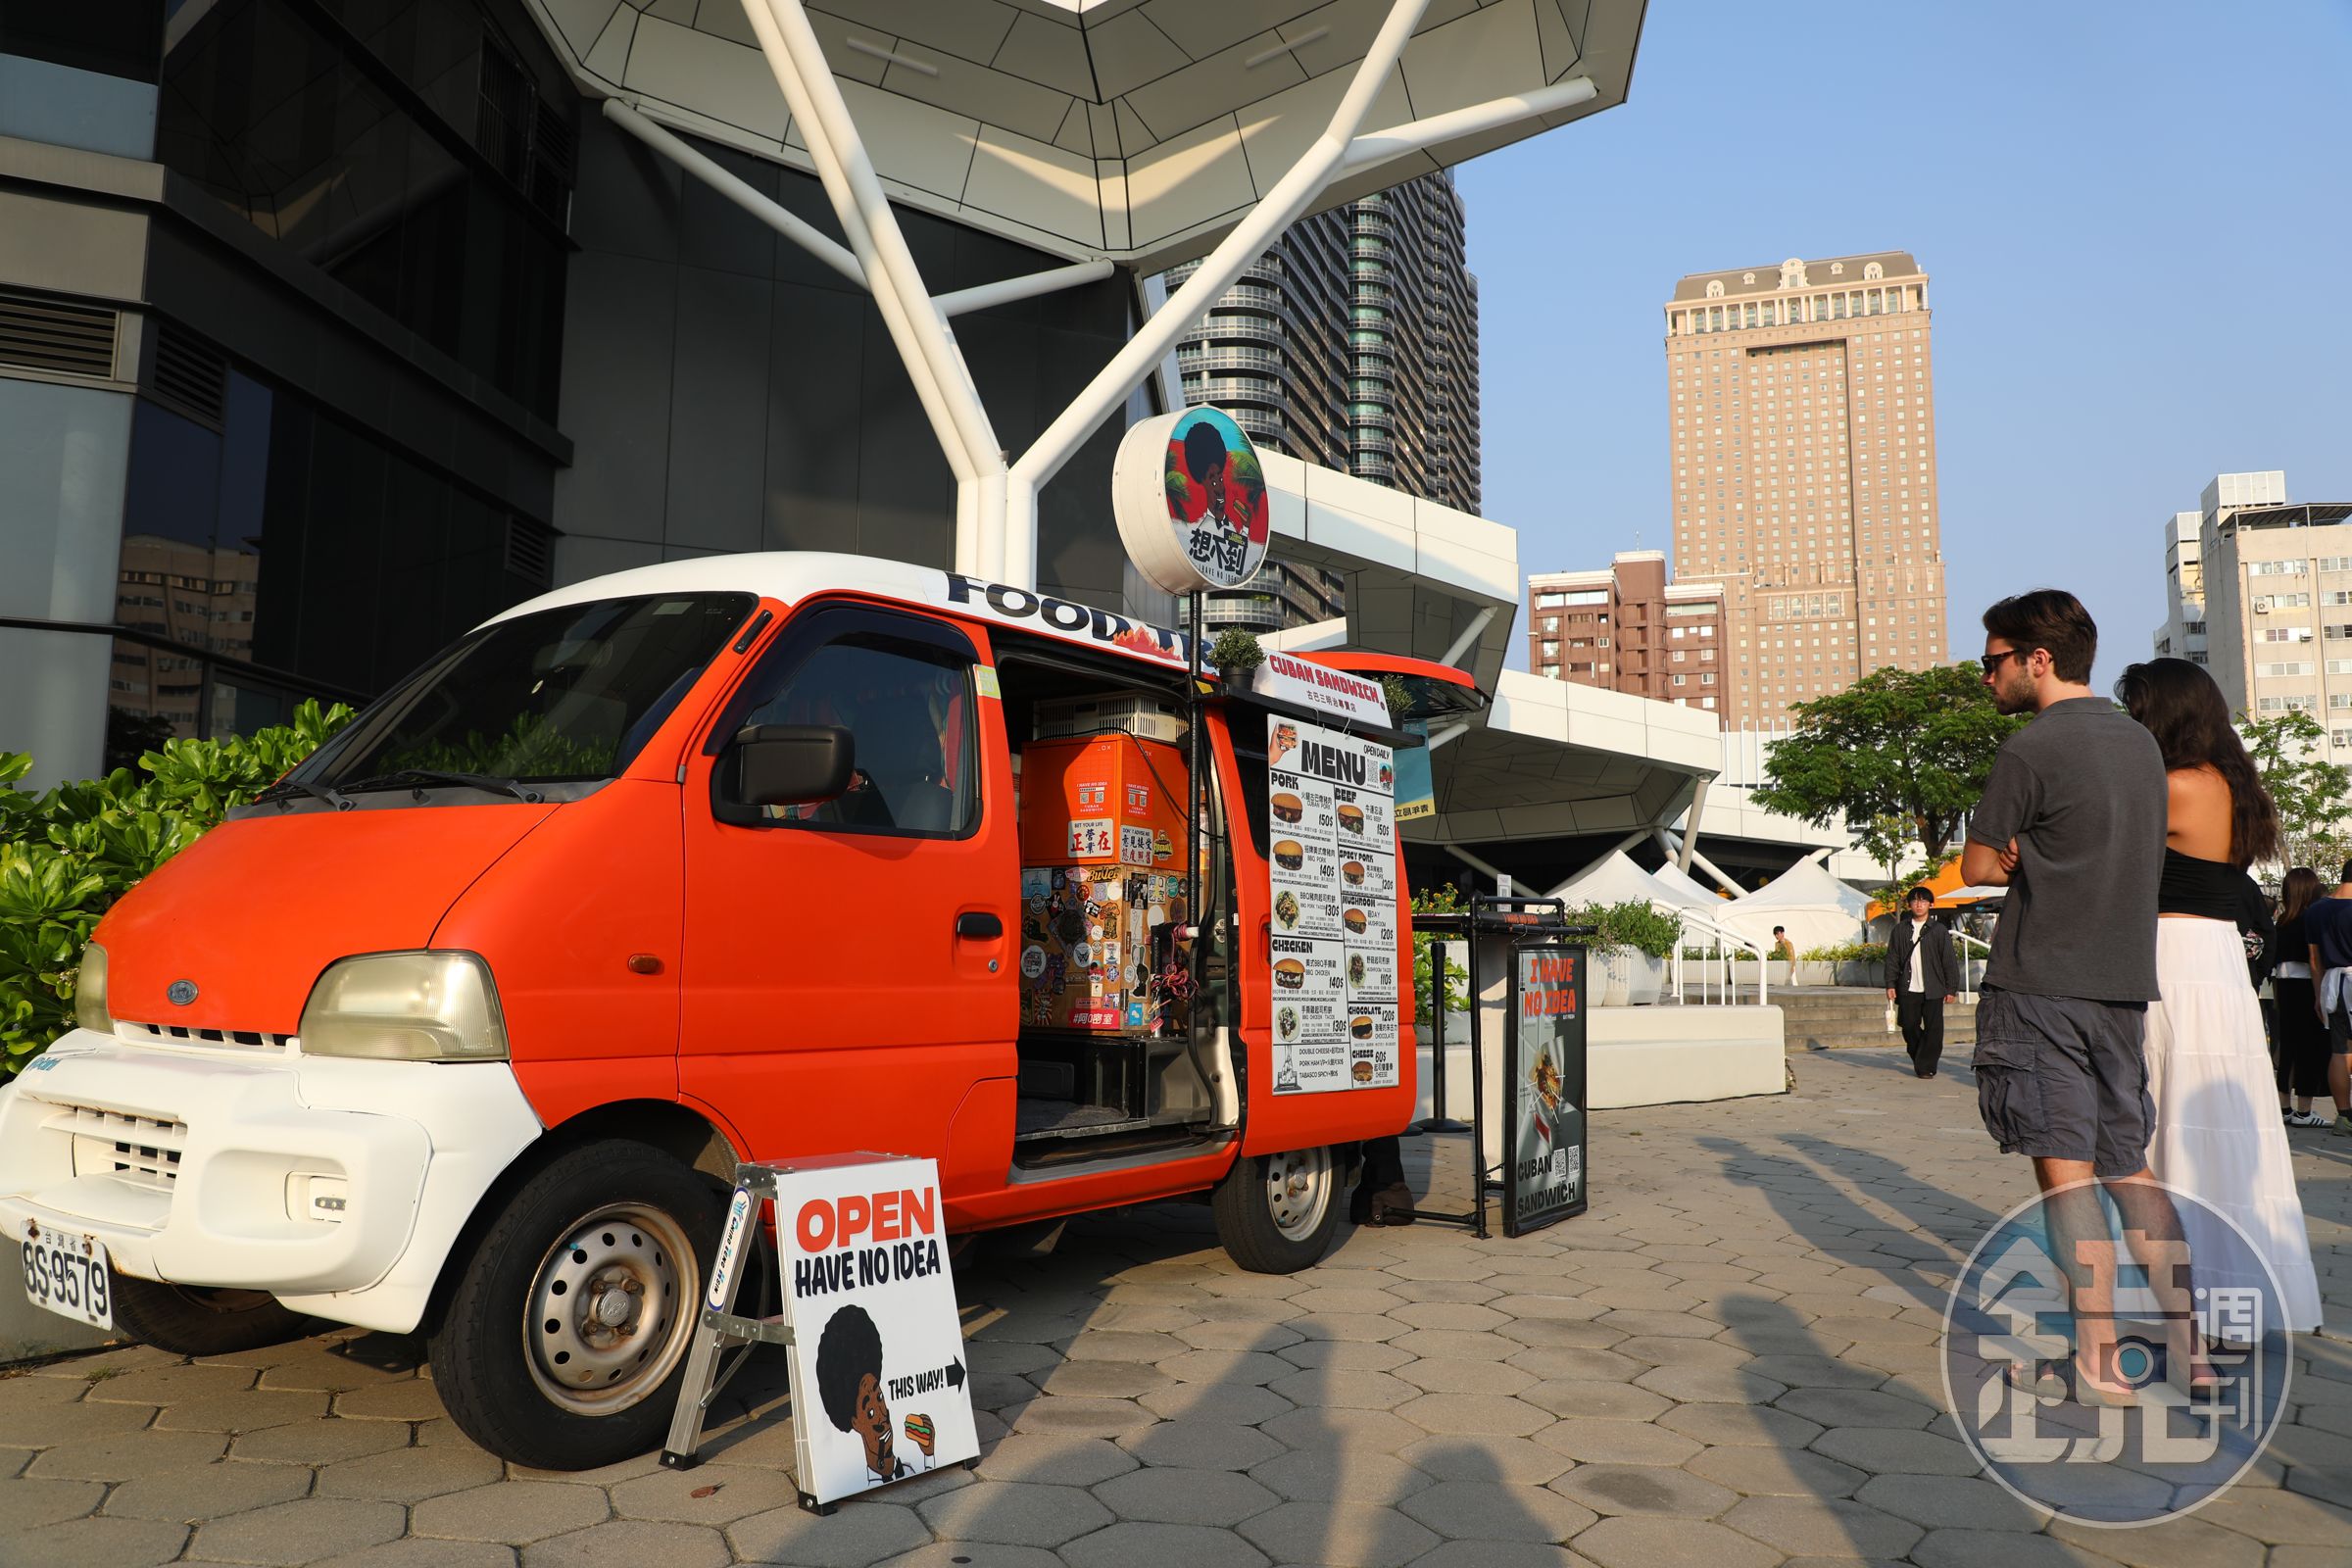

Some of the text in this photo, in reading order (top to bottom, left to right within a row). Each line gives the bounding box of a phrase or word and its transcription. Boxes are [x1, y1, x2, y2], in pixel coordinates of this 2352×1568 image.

[1189, 527, 1249, 576] 想不到
[945, 571, 1133, 641] FOOD
[1269, 654, 1380, 704] CUBAN SANDWICH
[1306, 689, 1357, 712] 古巴三明治專賣店
[1363, 744, 1390, 760] OPEN DAILY
[1301, 740, 1366, 786] MENU
[1271, 771, 1299, 790] PORK
[1335, 787, 1357, 804] BEEF
[1318, 813, 1334, 827] 150$
[1377, 823, 1390, 837] 150$
[1340, 849, 1374, 862] SPICY PORK
[1319, 864, 1335, 877] 140$
[1382, 879, 1394, 890] 120$
[1342, 896, 1376, 907] MUSHROOM
[1325, 905, 1340, 917] 130$
[1381, 928, 1394, 941] 120$
[1271, 939, 1313, 954] CHICKEN
[1531, 957, 1575, 983] I HAVE
[1329, 976, 1344, 989] 140$
[1380, 974, 1392, 985] 110$
[1348, 1006, 1382, 1015] CHOCOLATE
[1524, 989, 1576, 1017] NO IDEA
[1382, 1010, 1395, 1021] 120$
[1333, 1020, 1348, 1032] 130$
[1352, 1050, 1374, 1058] CHEESE
[1375, 1052, 1387, 1062] 60$
[1518, 1154, 1552, 1182] CUBAN
[1517, 1182, 1576, 1216] SANDWICH
[796, 1186, 935, 1253] OPEN
[795, 1239, 942, 1298] HAVE NO IDEA
[888, 1368, 945, 1401] THIS WAY!
